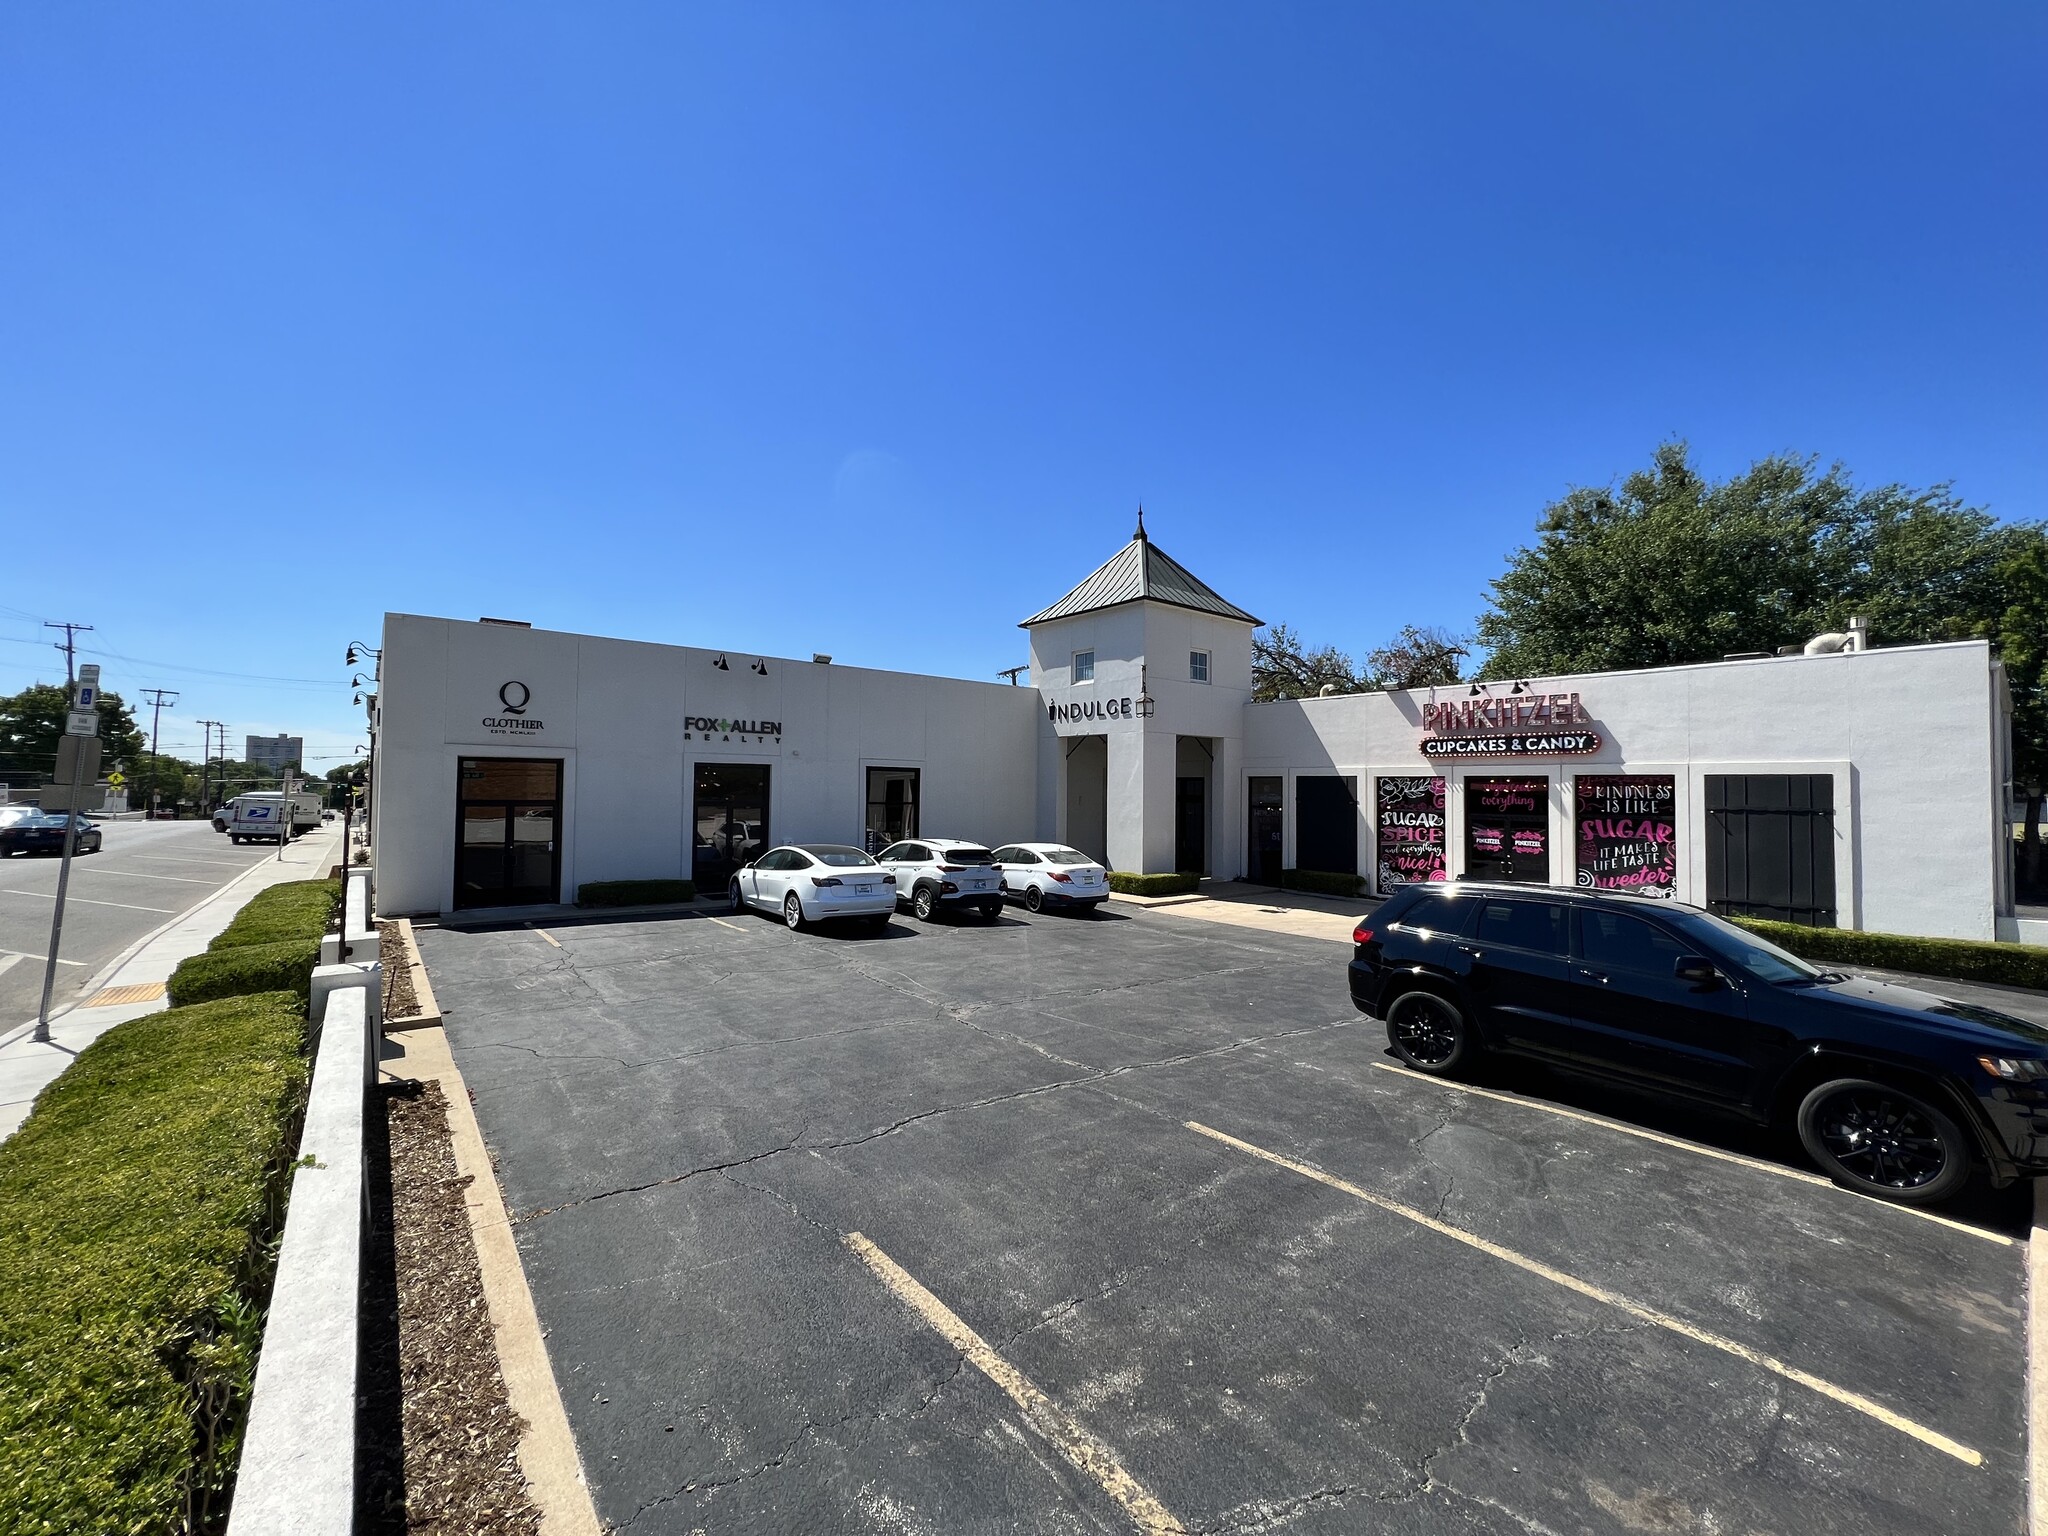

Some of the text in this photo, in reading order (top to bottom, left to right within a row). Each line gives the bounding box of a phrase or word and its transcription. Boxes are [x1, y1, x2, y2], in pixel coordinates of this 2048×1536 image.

[499, 680, 531, 715] Q
[1423, 692, 1589, 731] PINKITZEL
[482, 717, 544, 730] CLOTHIER
[684, 732, 781, 744] REALTY
[1426, 735, 1588, 754] CUPCAKES & CANDY
[1595, 785, 1671, 800] KINDNESS
[1481, 793, 1535, 812] everything
[1606, 799, 1659, 814] IS LIKE
[1381, 811, 1444, 828] SUGAR
[1382, 826, 1444, 842] SPICE
[1581, 818, 1674, 844] SUGAR
[1384, 841, 1443, 857] and everything
[1600, 841, 1659, 859] IT MAKES
[1397, 852, 1434, 870] nice!
[1593, 852, 1660, 871] LIFE TASTE
